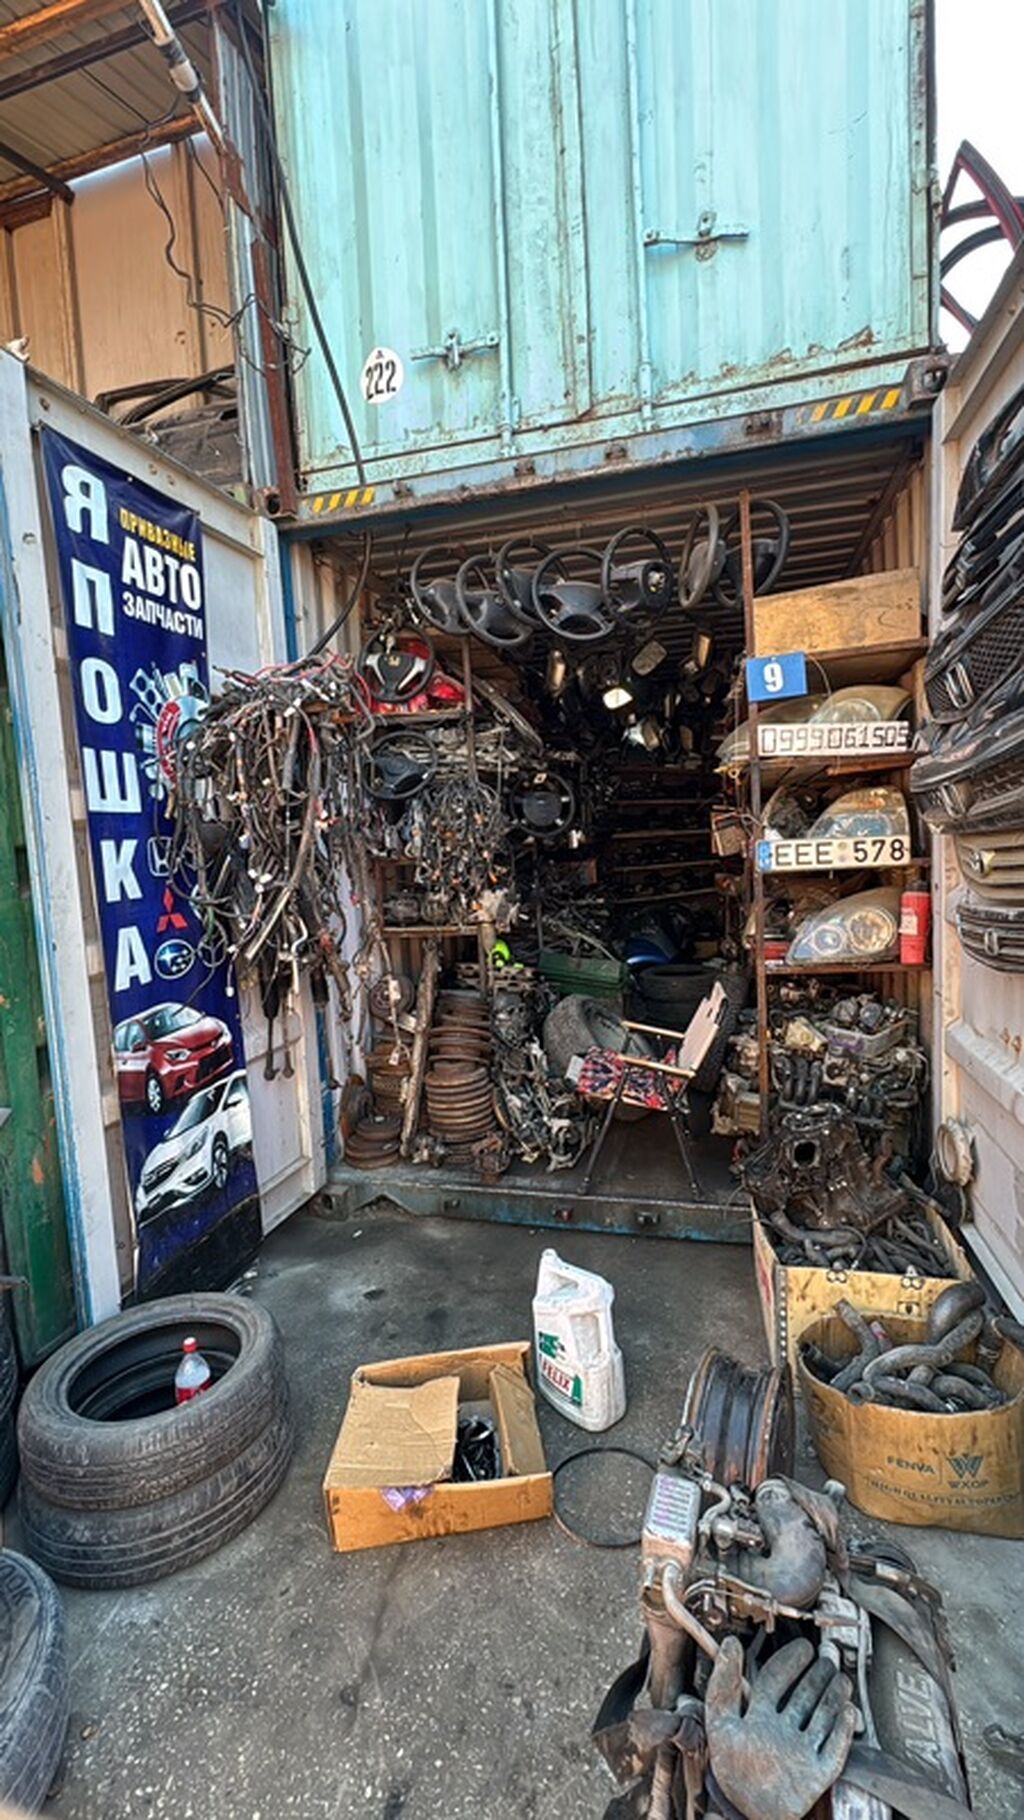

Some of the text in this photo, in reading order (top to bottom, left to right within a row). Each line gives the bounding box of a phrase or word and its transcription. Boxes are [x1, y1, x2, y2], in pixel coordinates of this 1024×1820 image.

[365, 359, 397, 400] 222
[122, 536, 202, 611] АВТО
[122, 591, 204, 640] ЗАПЧАСТИ
[762, 662, 784, 693] 9
[61, 464, 153, 992] ЯПОШКА
[775, 842, 834, 867] EEE
[853, 837, 906, 863] 578
[542, 1359, 571, 1392] FELIX
[0, 1562, 34, 1606] OOK
[896, 1668, 941, 1772] ALVE
